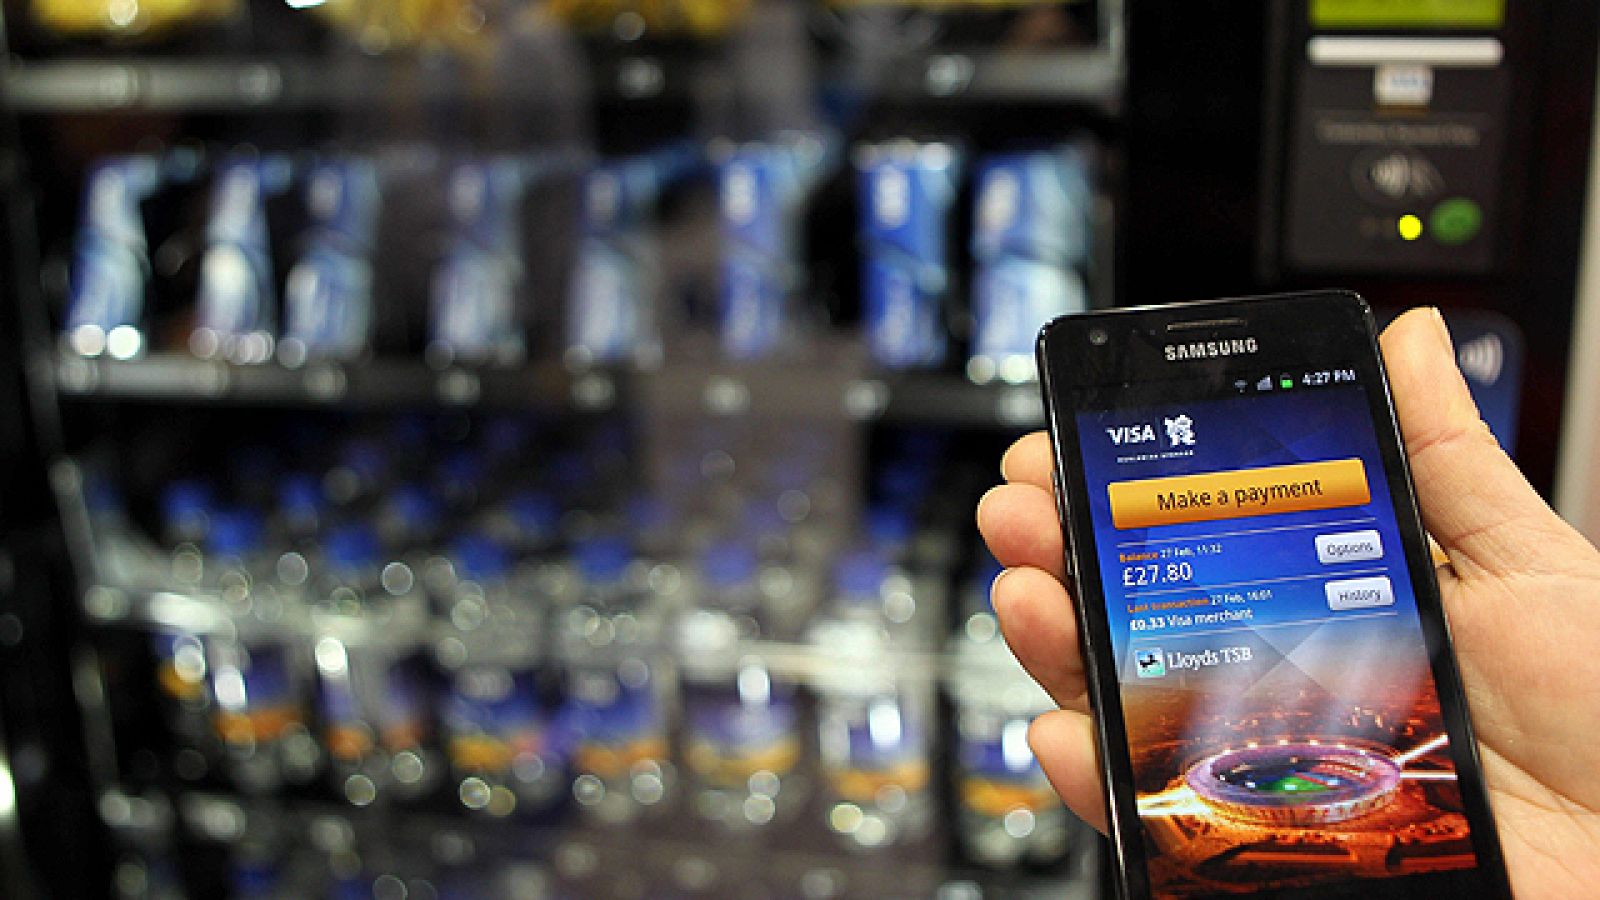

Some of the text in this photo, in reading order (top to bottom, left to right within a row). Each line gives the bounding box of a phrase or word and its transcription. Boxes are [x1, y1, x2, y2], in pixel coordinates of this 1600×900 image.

[1164, 337, 1259, 361] SAMSUNG
[1302, 369, 1356, 386] 4:27 PM
[1106, 424, 1156, 446] VISA
[1156, 478, 1323, 512] Make a payment
[1326, 540, 1374, 558] Options
[1123, 561, 1193, 586] £27.80
[1337, 587, 1382, 605] History
[1127, 603, 1149, 614] Last
[1167, 614, 1193, 627] Visa
[1195, 607, 1254, 624] merchant
[1167, 646, 1254, 671] Lloyds TSB
